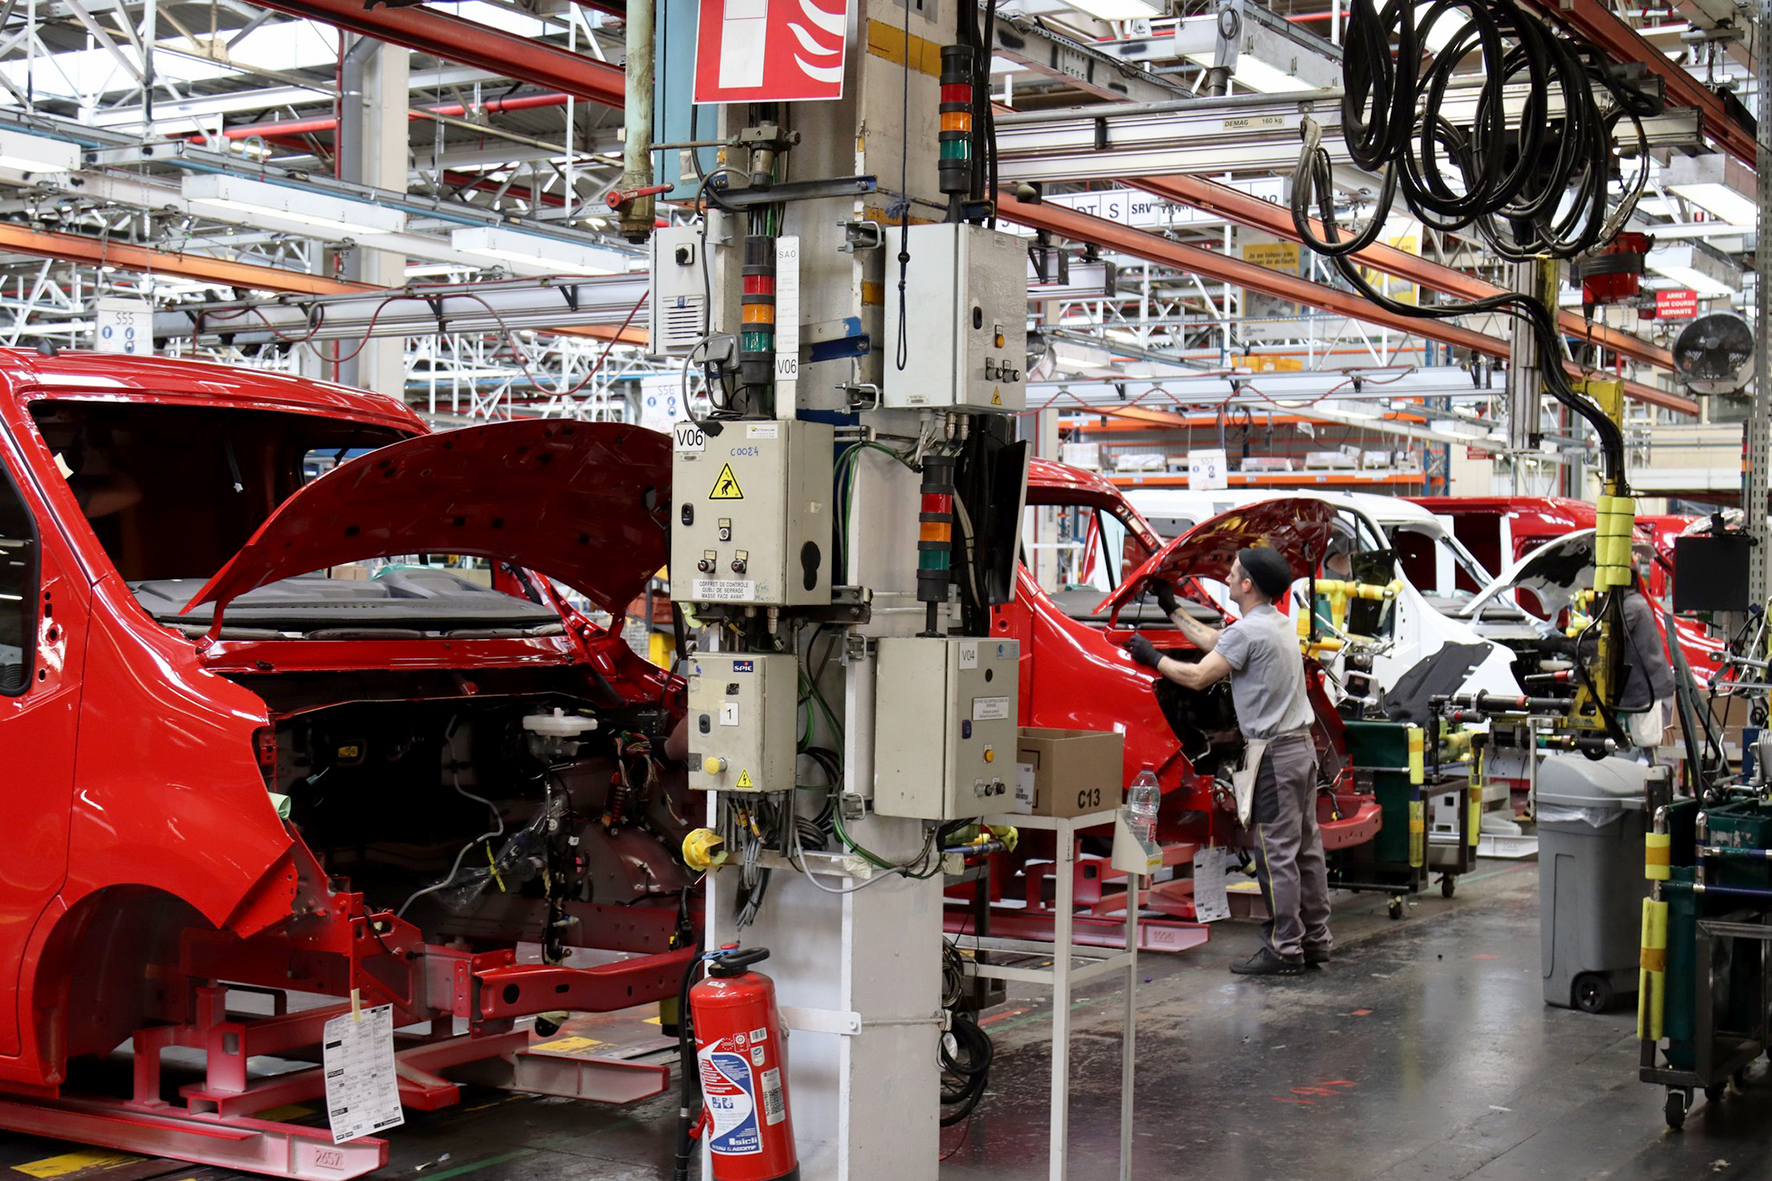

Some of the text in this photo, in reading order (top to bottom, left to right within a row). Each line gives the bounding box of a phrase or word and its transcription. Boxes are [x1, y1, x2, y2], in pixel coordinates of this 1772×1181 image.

[1109, 203, 1119, 218] S
[1131, 203, 1152, 214] SRV
[778, 249, 797, 259] SAO
[116, 312, 134, 325] S55
[777, 359, 797, 374] V06
[658, 385, 675, 396] S56
[677, 429, 703, 446] V06
[962, 650, 975, 661] V04
[727, 708, 732, 720] 1
[1077, 788, 1101, 809] C13
